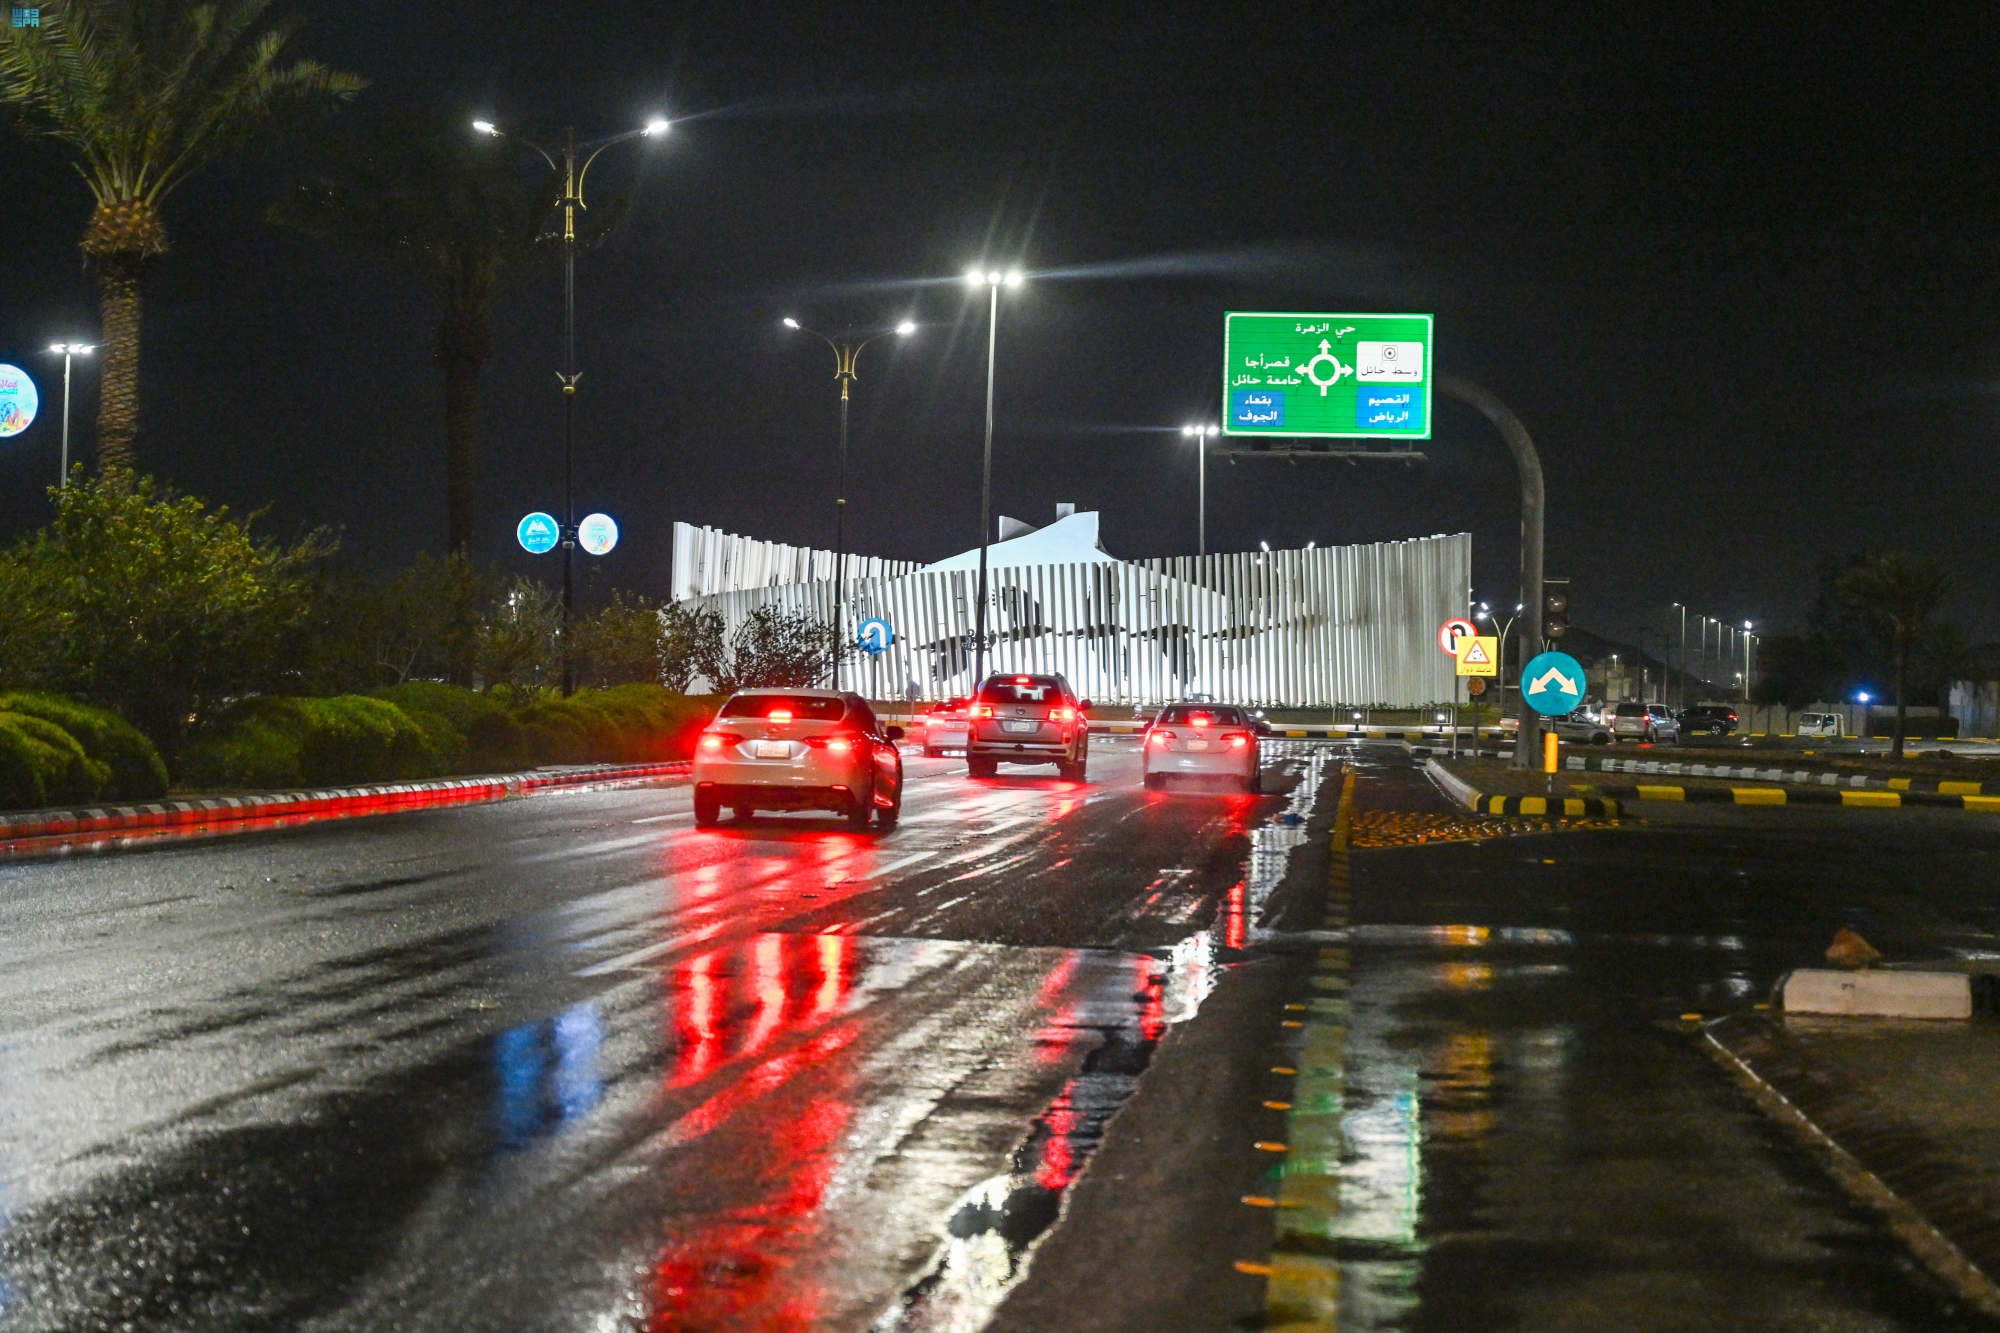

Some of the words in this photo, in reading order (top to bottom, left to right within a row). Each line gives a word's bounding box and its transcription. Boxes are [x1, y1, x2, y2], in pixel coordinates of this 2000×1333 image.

[1295, 323, 1329, 334] الزهرة
[1335, 326, 1356, 338] حي
[1361, 366, 1386, 376] حائل
[1392, 366, 1418, 377] وسط
[1232, 374, 1261, 386] حائل
[1266, 375, 1302, 387] جامعة
[1245, 394, 1272, 406] بقعاء
[1369, 394, 1410, 407] القصيم
[1239, 409, 1278, 423] الجوف
[1368, 410, 1409, 423] الرياض
